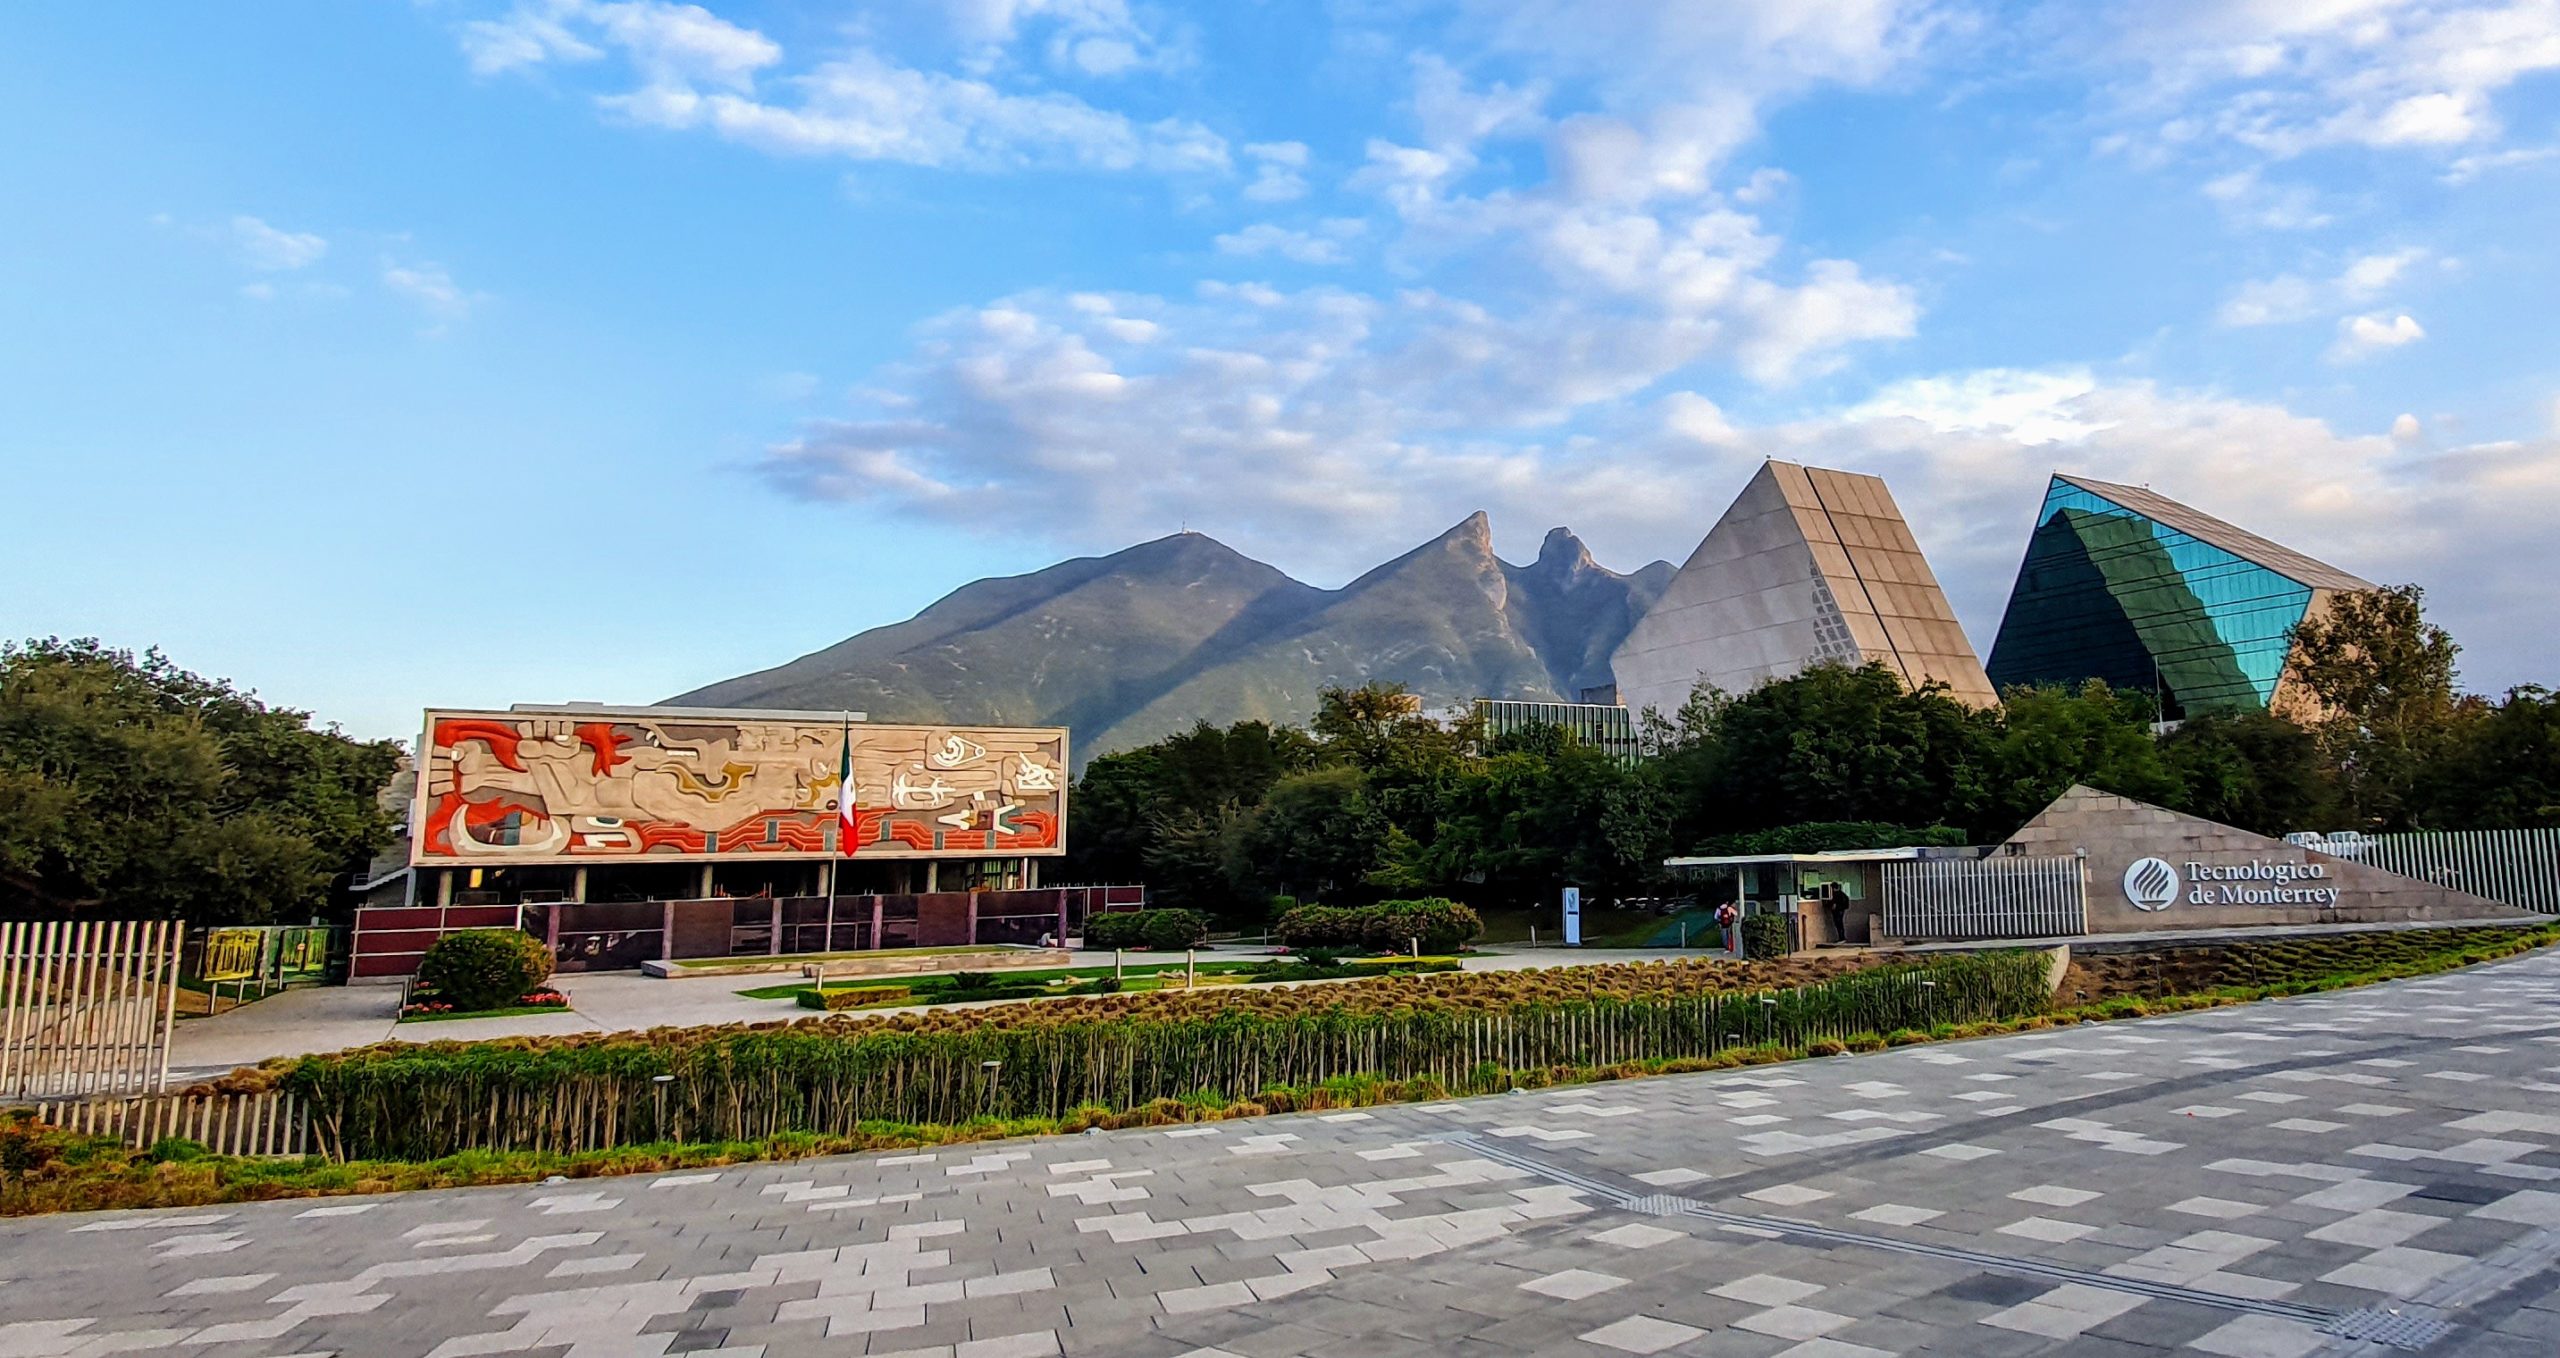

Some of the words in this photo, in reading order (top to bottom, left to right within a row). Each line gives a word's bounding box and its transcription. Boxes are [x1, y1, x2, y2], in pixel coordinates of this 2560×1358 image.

[2185, 859, 2324, 885] Tecnológico
[2188, 884, 2215, 905] de
[2220, 885, 2341, 908] Monterrey
